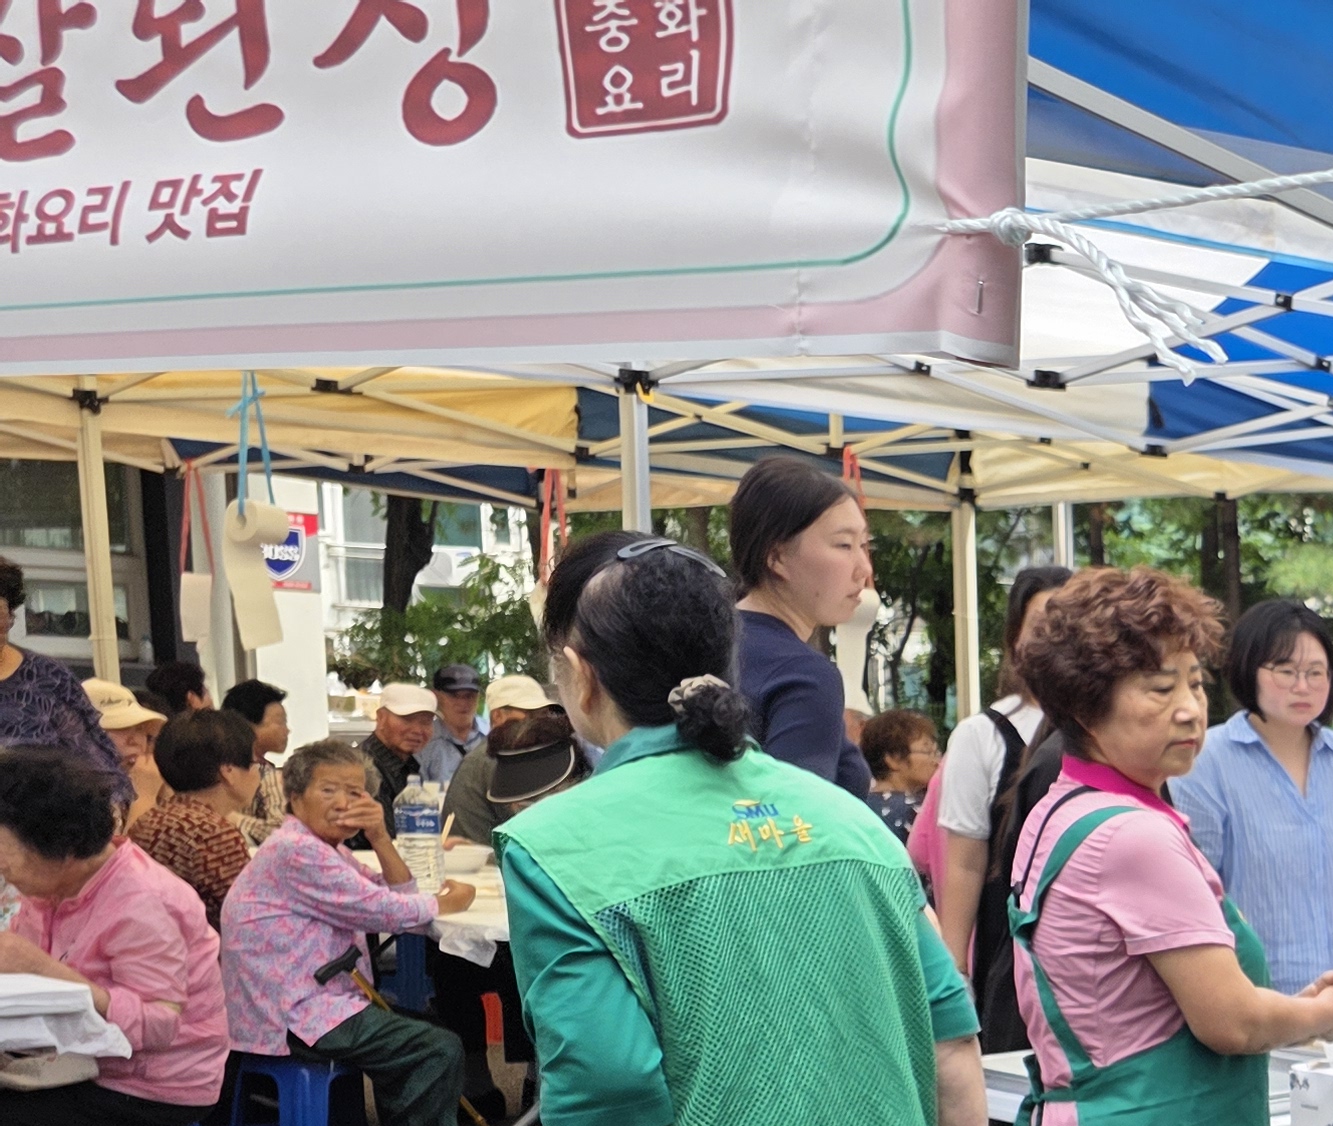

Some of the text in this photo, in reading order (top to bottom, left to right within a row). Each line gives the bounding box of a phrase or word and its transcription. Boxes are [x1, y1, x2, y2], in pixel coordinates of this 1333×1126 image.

[595, 50, 700, 116] 요리
[145, 168, 264, 244] 맛집
[728, 814, 813, 852] 새마을
[732, 803, 779, 819] SMU
